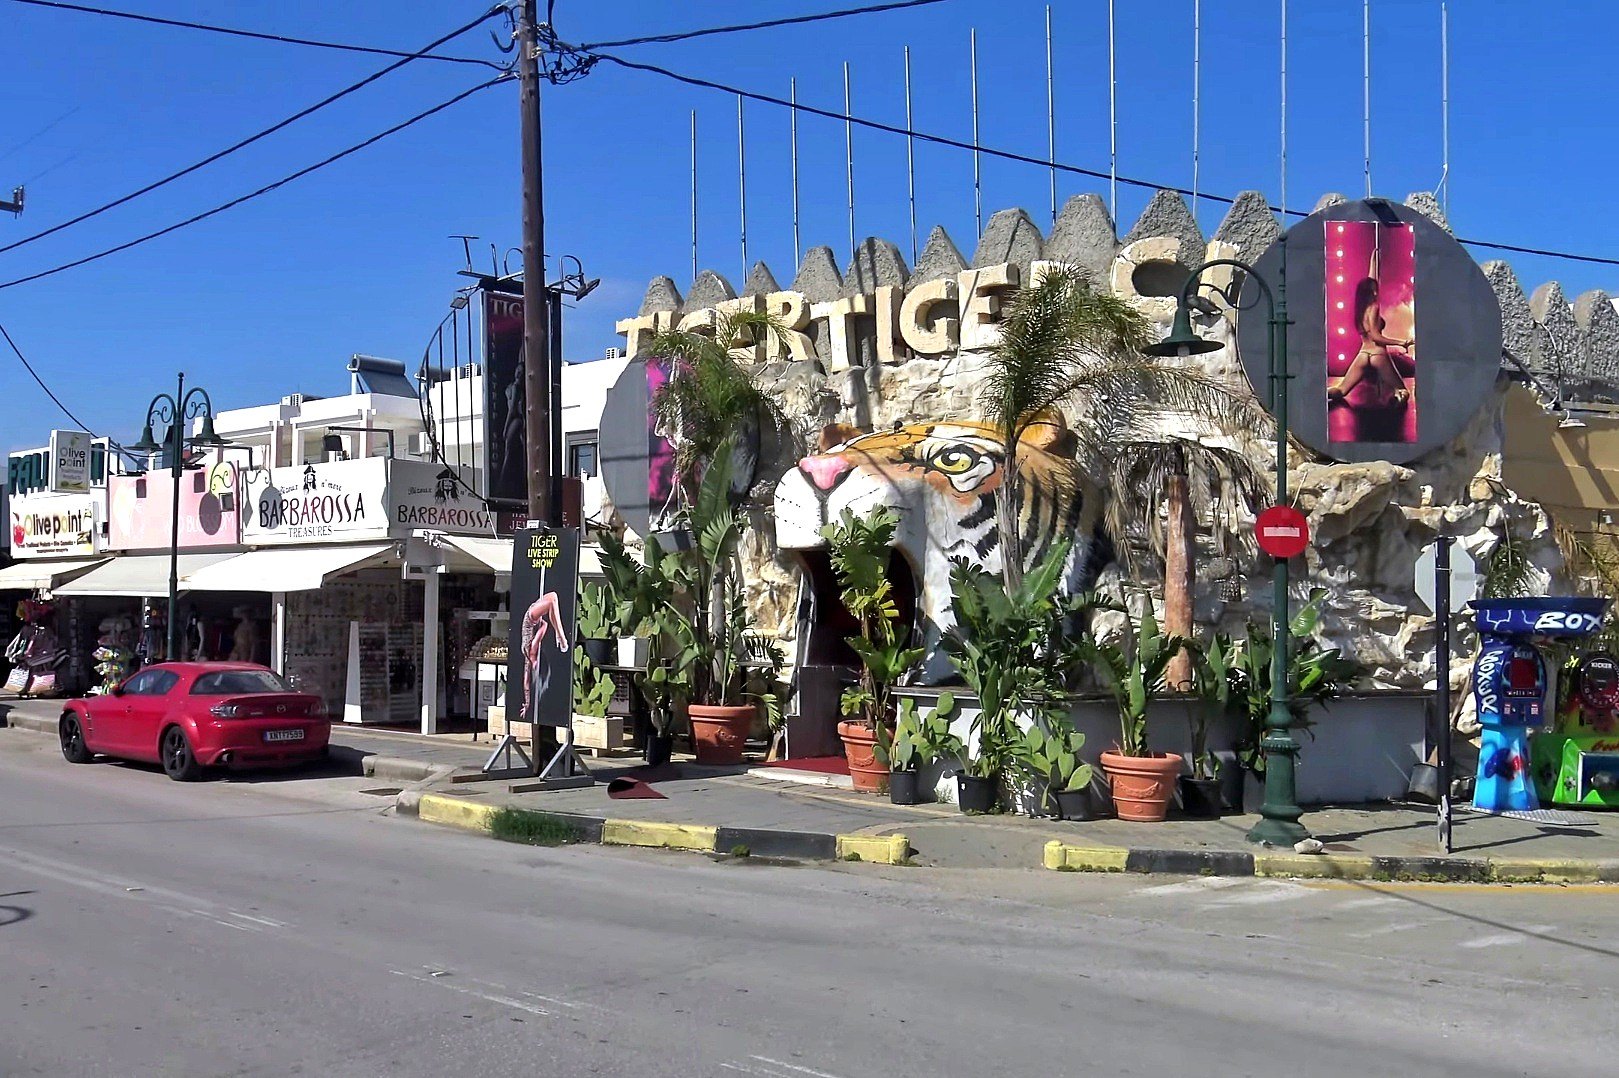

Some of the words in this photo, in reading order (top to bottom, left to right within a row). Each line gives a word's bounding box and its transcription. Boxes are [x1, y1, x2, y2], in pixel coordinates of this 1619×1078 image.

[810, 260, 1088, 373] TIGE
[59, 446, 86, 458] Olive
[59, 457, 86, 468] point
[259, 493, 365, 528] BARBAROSSA
[398, 504, 493, 529] BARBAROSSA
[24, 513, 52, 536] Olive
[53, 509, 82, 539] point
[288, 525, 333, 538] TREASURES
[531, 535, 558, 548] TIGER
[527, 548, 542, 558] LIVE
[542, 548, 560, 558] STRIP
[532, 558, 554, 568] SHOW
[1477, 650, 1504, 714] BOXER
